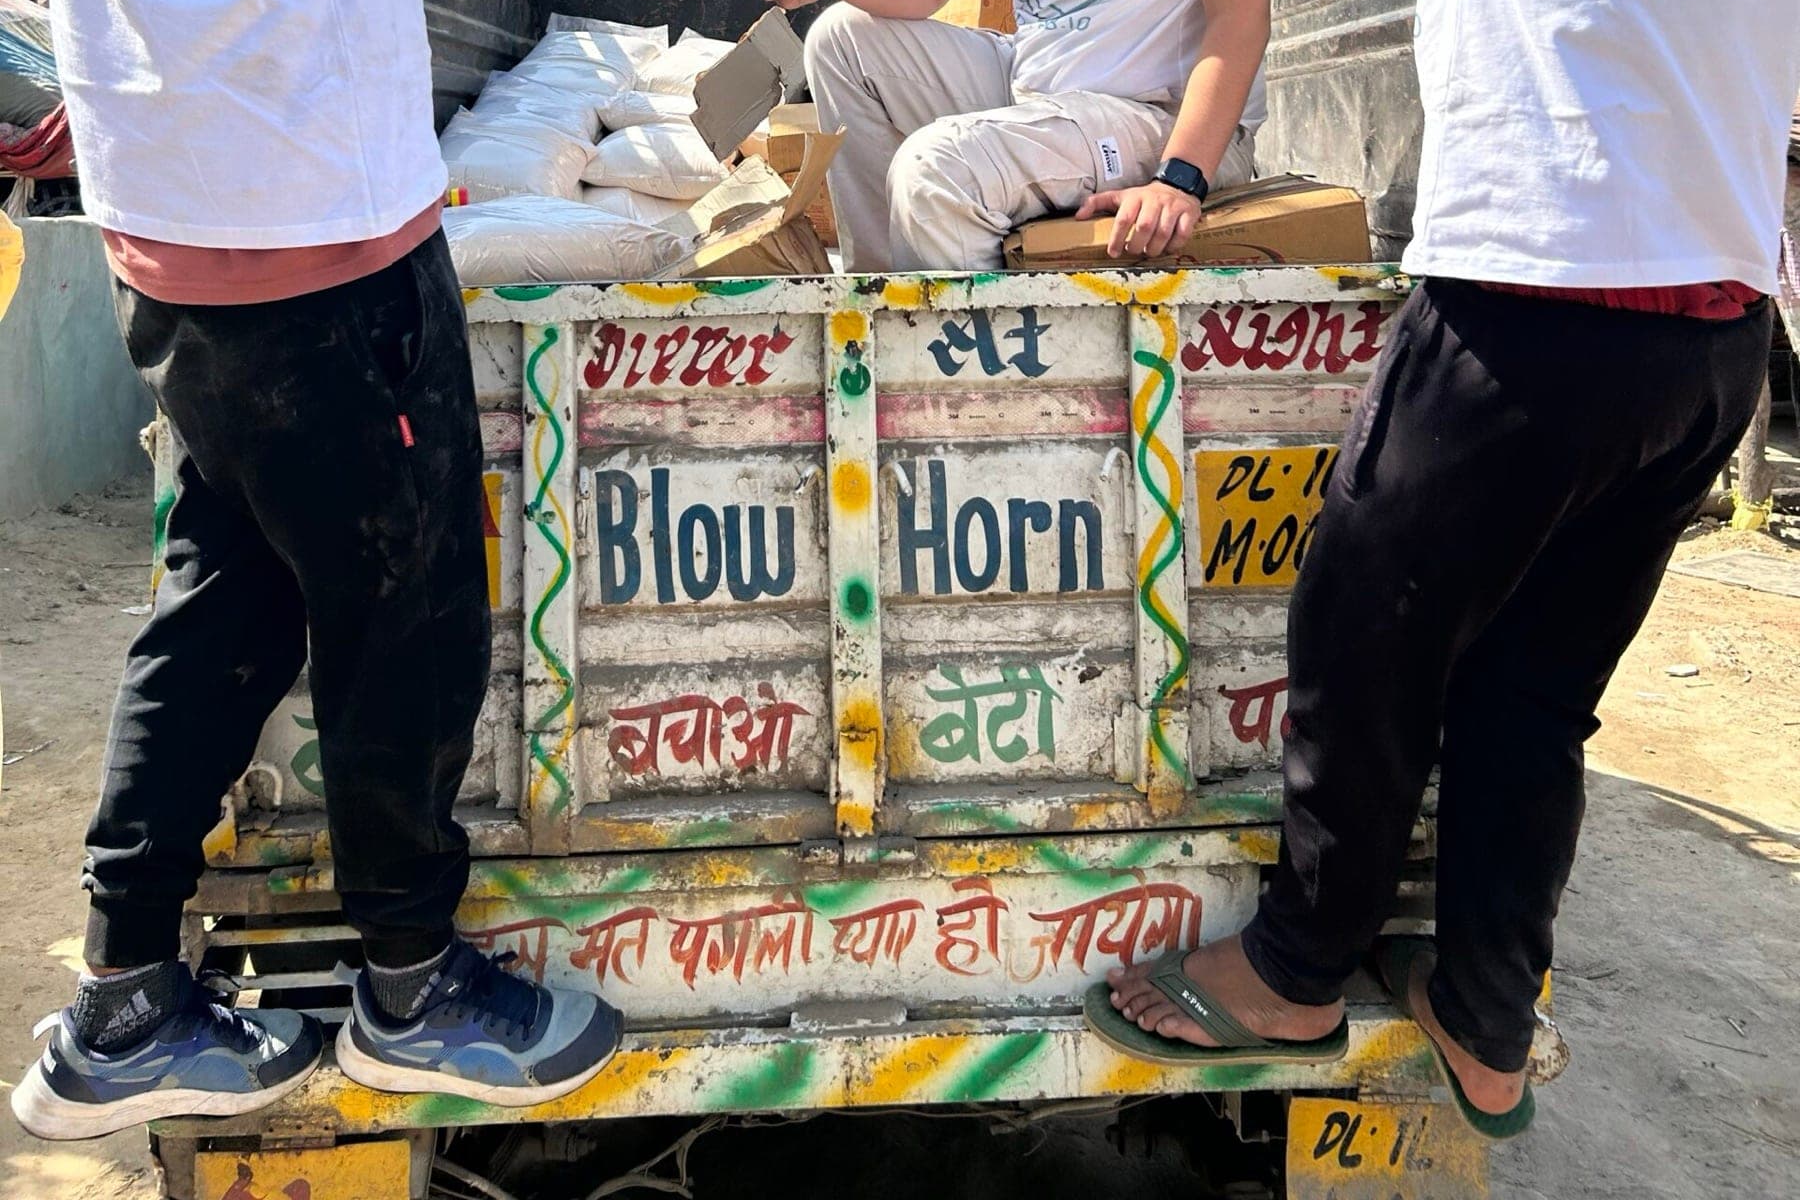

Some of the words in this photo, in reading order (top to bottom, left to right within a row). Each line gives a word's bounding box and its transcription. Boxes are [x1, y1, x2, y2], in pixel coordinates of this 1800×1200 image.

[595, 467, 797, 604] Blow
[896, 459, 1105, 595] Horn
[607, 681, 813, 776] बचाओ
[919, 661, 1064, 765] बेटी
[570, 907, 659, 990] मत
[935, 876, 1009, 977] हो
